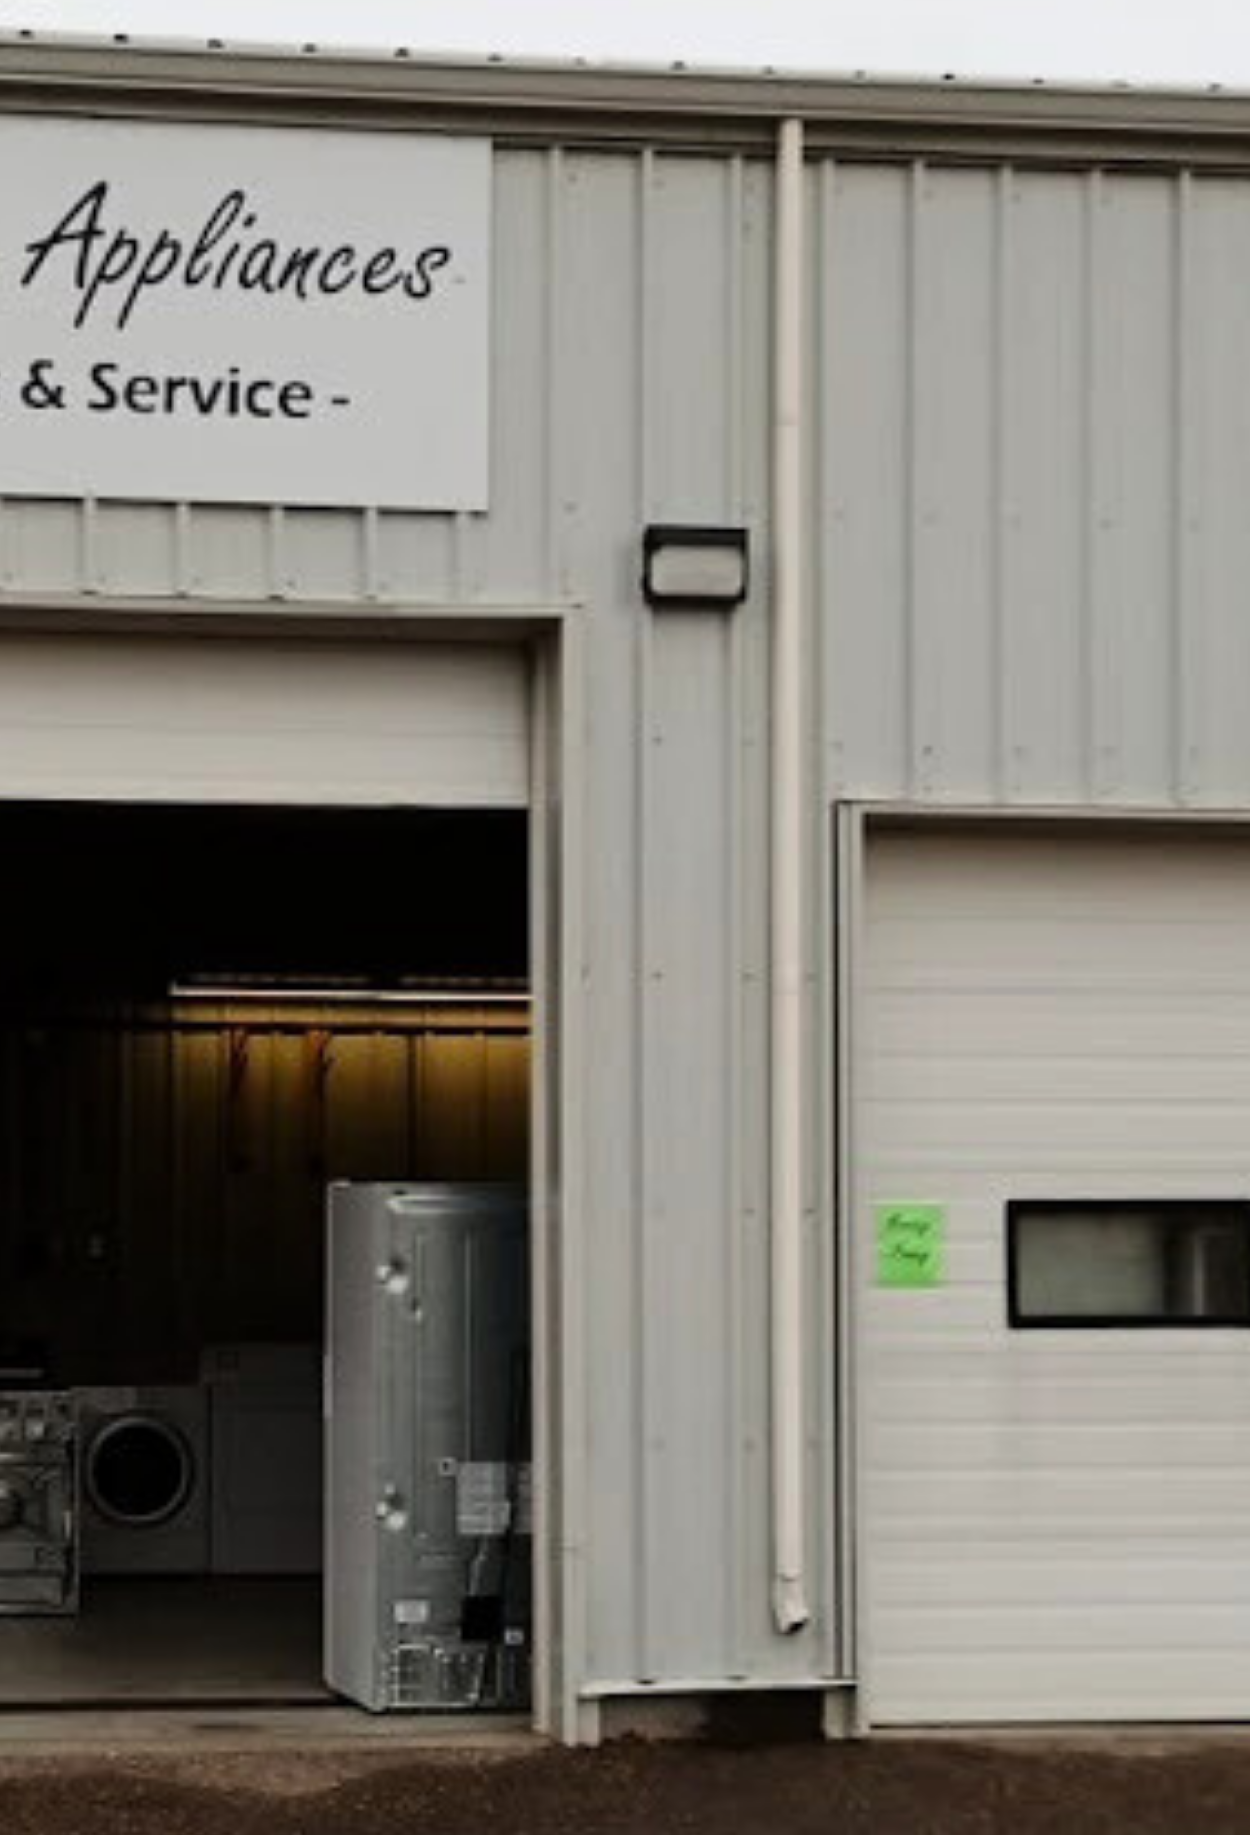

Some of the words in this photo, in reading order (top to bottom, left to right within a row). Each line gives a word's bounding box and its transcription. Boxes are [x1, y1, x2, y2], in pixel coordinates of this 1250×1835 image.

[20, 180, 451, 331] Appliances
[20, 359, 67, 410] &
[87, 362, 313, 419] Service
